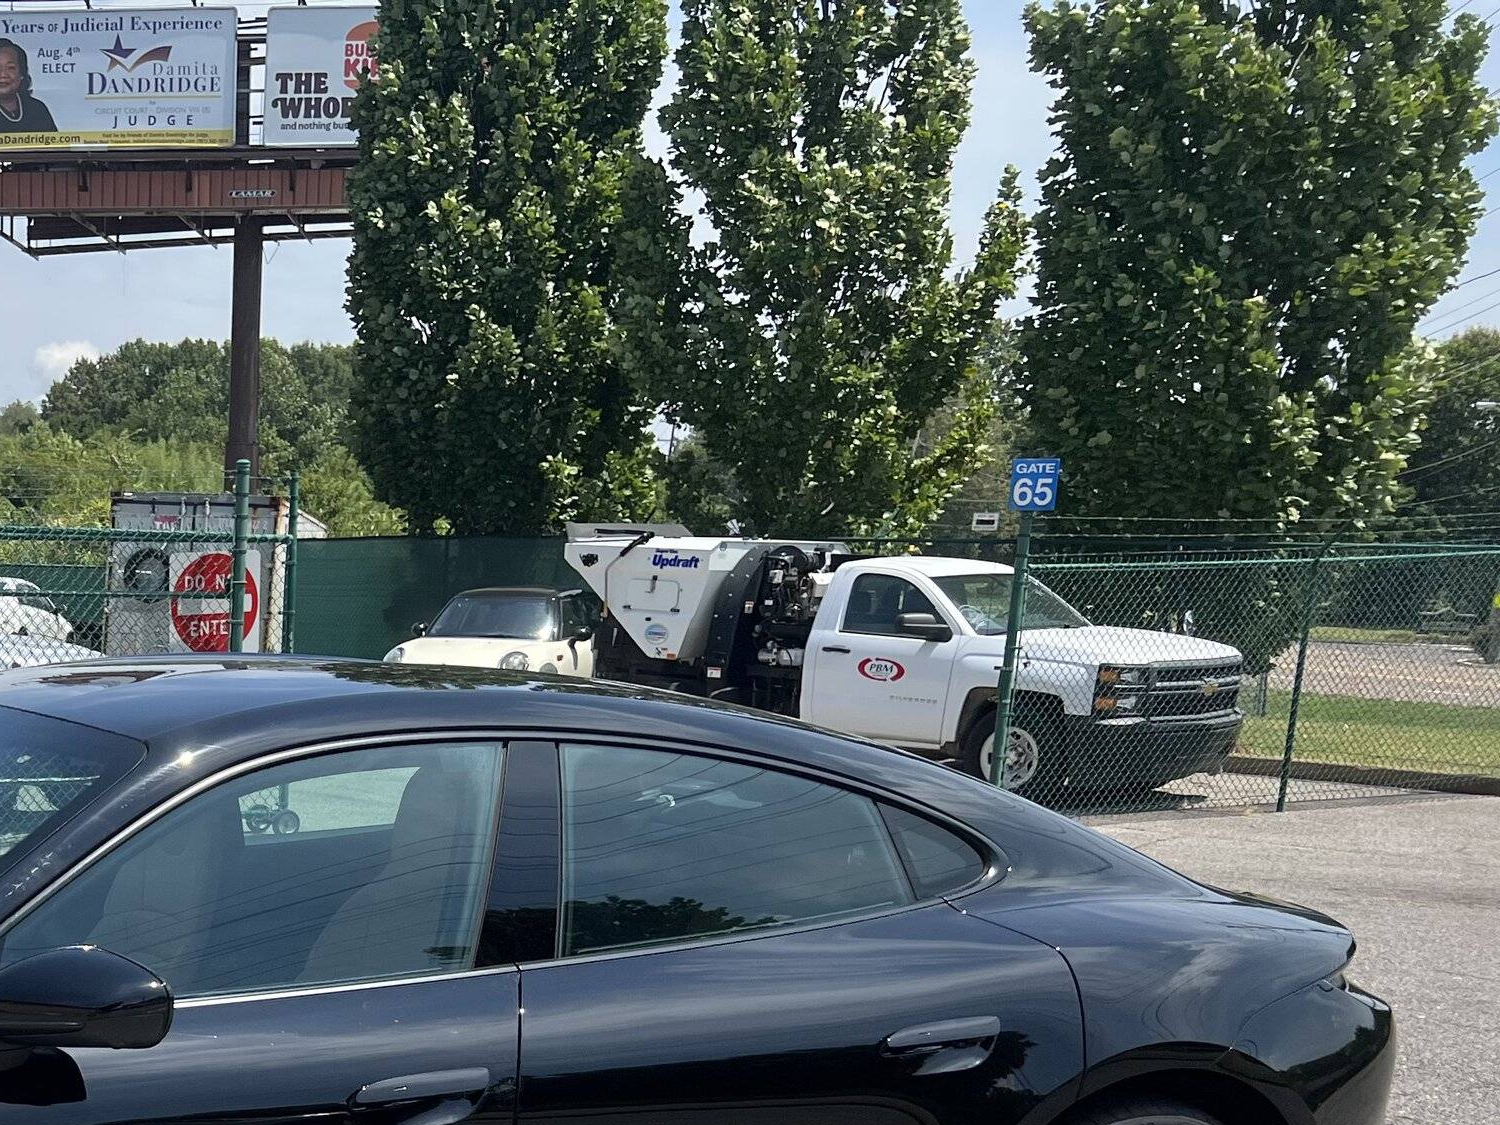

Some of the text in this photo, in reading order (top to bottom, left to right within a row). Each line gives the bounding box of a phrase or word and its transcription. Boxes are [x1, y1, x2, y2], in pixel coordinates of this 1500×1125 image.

[1, 19, 45, 34] Years
[47, 23, 59, 33] OF
[61, 17, 123, 35] Judicial
[130, 16, 223, 35] Experience
[37, 46, 80, 60] Aug. 4th
[42, 62, 76, 74] ELECT
[152, 61, 219, 76] Damita
[87, 72, 221, 95] DANDRIDGE
[275, 72, 329, 95] THE
[271, 97, 357, 119] WHOP
[112, 115, 194, 129] JUDGE
[280, 121, 296, 130] and
[297, 121, 332, 131] nothing
[1016, 463, 1056, 474] GATE
[1012, 477, 1054, 507] 65
[652, 553, 700, 569] Updraft
[184, 574, 206, 590] DO
[190, 619, 229, 637] ENTE
[869, 663, 894, 673] PBM
